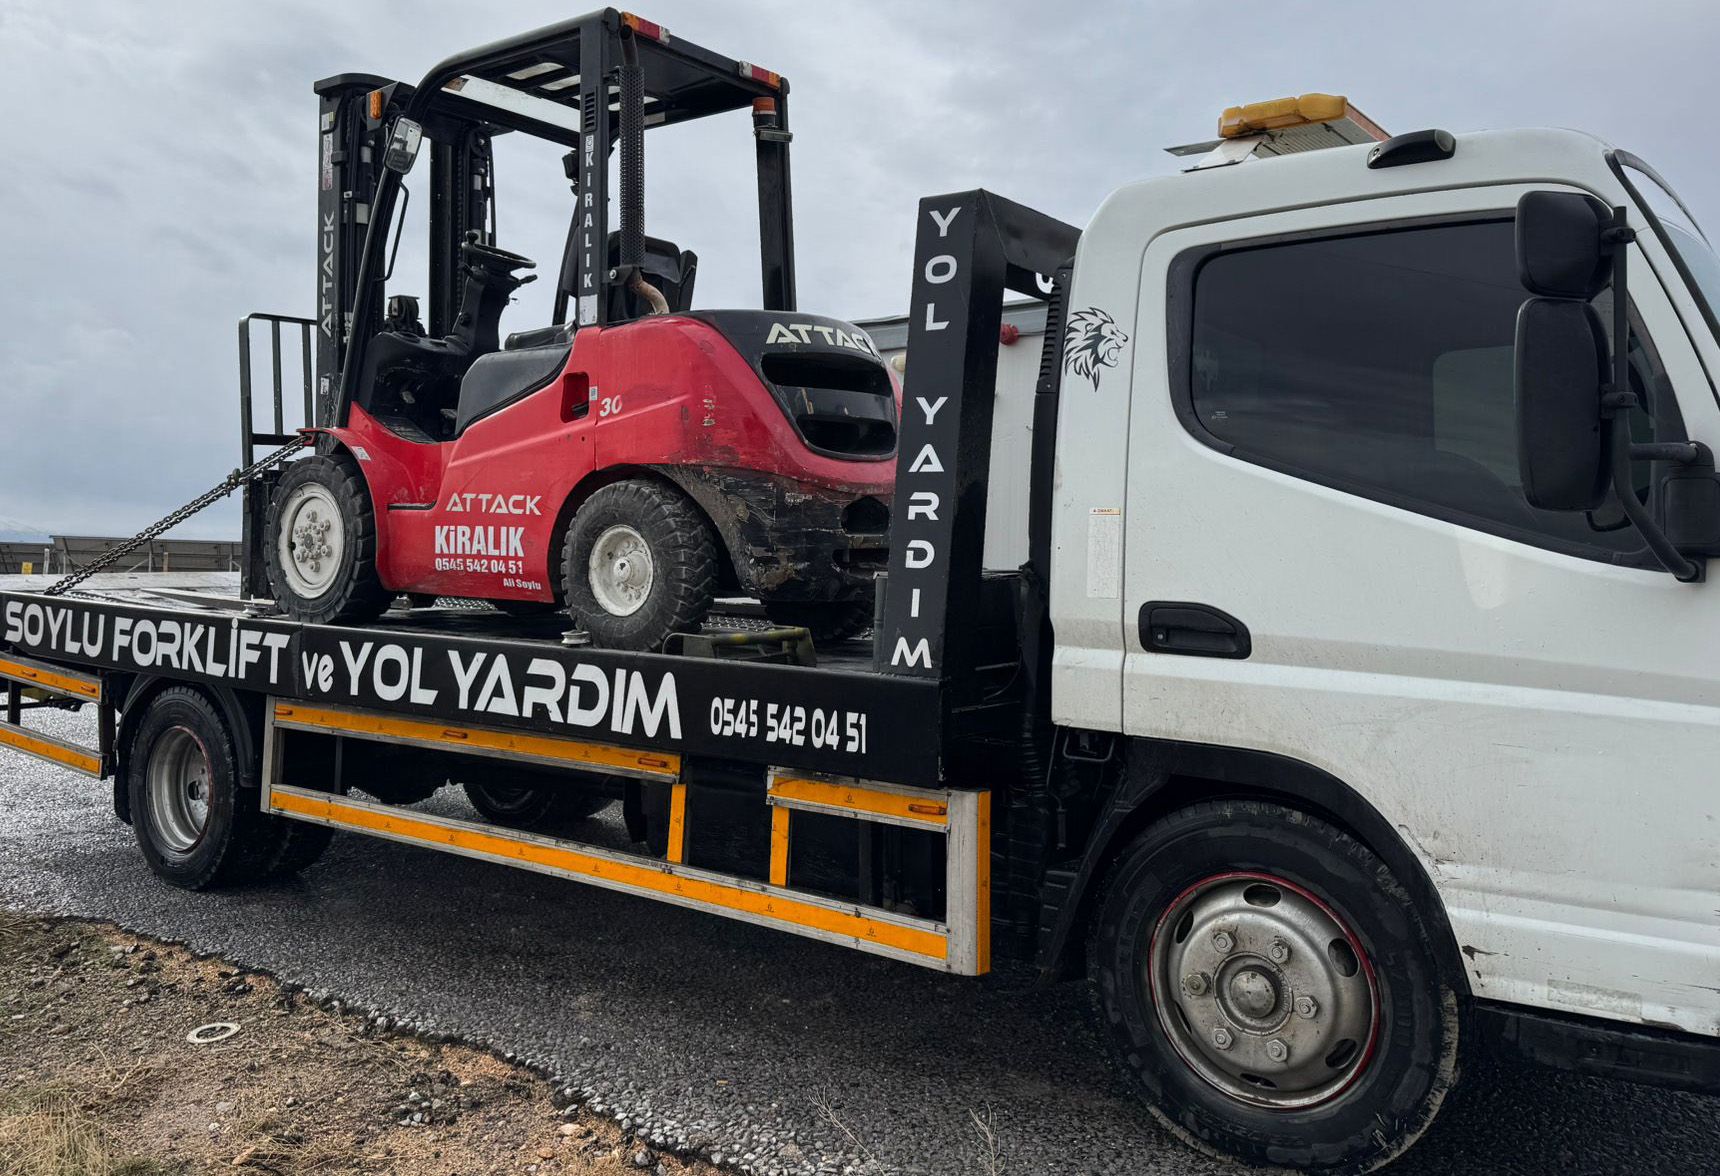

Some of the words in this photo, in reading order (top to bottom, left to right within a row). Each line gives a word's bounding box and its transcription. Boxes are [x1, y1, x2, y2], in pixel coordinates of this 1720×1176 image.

[321, 211, 335, 338] ATTACK
[924, 206, 961, 331] YOL
[600, 394, 623, 417] 30
[446, 493, 542, 516] ATTACK
[891, 396, 948, 669] YARDIM
[435, 557, 464, 572] 0545
[466, 558, 489, 573] 542
[490, 560, 506, 573] 04
[508, 561, 523, 575] 51
[4, 600, 105, 658] SOYLU
[302, 651, 334, 692] ve
[340, 641, 439, 706] YOL
[448, 649, 683, 740] YARDIM
[710, 696, 758, 737] 0545
[766, 703, 806, 746] 542
[811, 708, 840, 750] 04
[846, 712, 867, 754] 51
